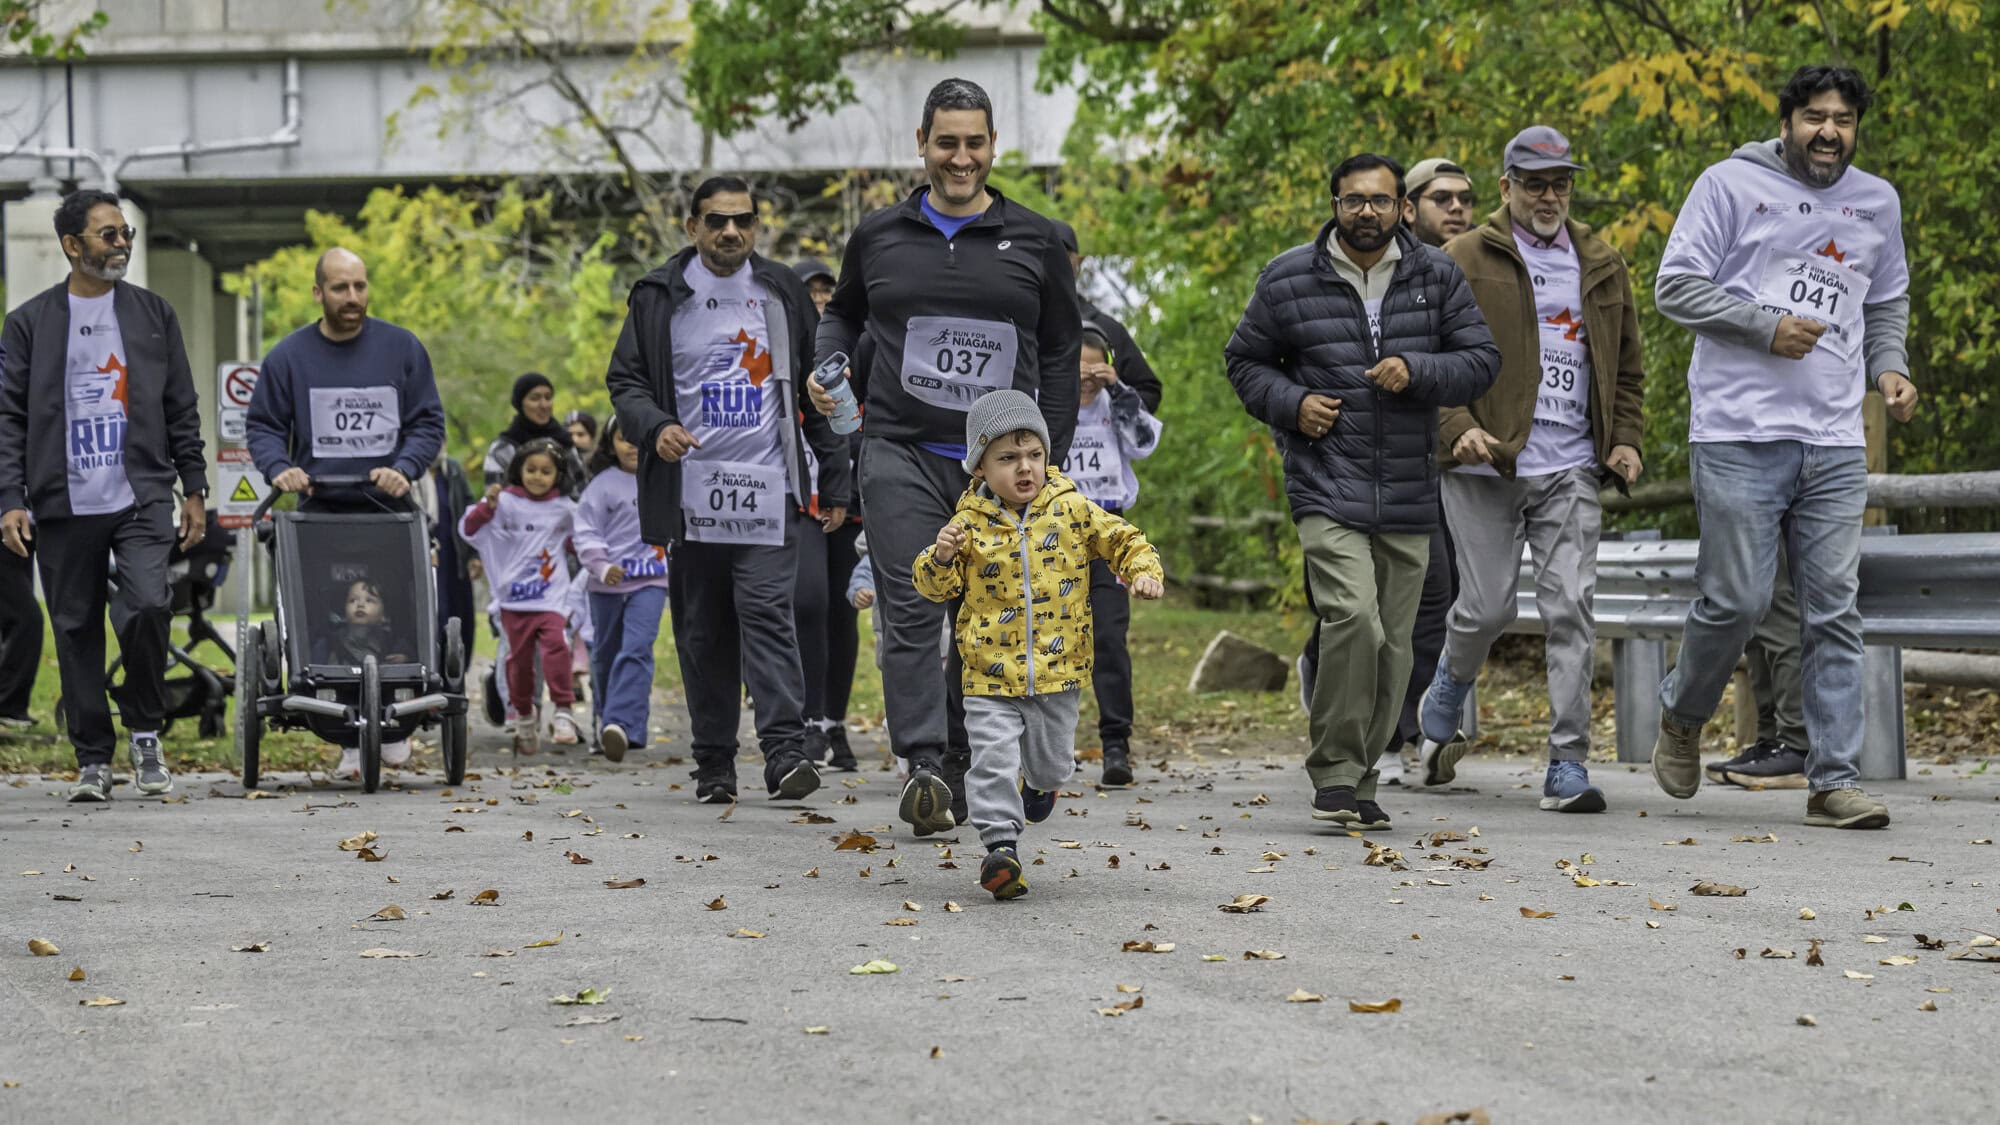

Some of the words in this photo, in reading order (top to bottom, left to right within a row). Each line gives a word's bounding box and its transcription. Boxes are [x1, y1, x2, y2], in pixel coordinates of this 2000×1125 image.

[1810, 265, 1825, 275] RUN
[1827, 270, 1840, 279] FOR
[1808, 272, 1849, 296] NIAGARA
[1789, 279, 1840, 315] 041
[952, 338, 1002, 352] NIAGARA
[1544, 348, 1559, 356] RUN
[1560, 350, 1573, 359] FOR
[936, 348, 992, 378] 037
[912, 376, 938, 388] 5K/2K
[1538, 364, 1575, 392] 39
[701, 382, 763, 413] RUN
[335, 411, 375, 431] 027
[711, 412, 761, 428] NIAGARA
[1061, 451, 1101, 473] 014
[722, 478, 767, 490] NIAGARA
[709, 488, 758, 513] 014
